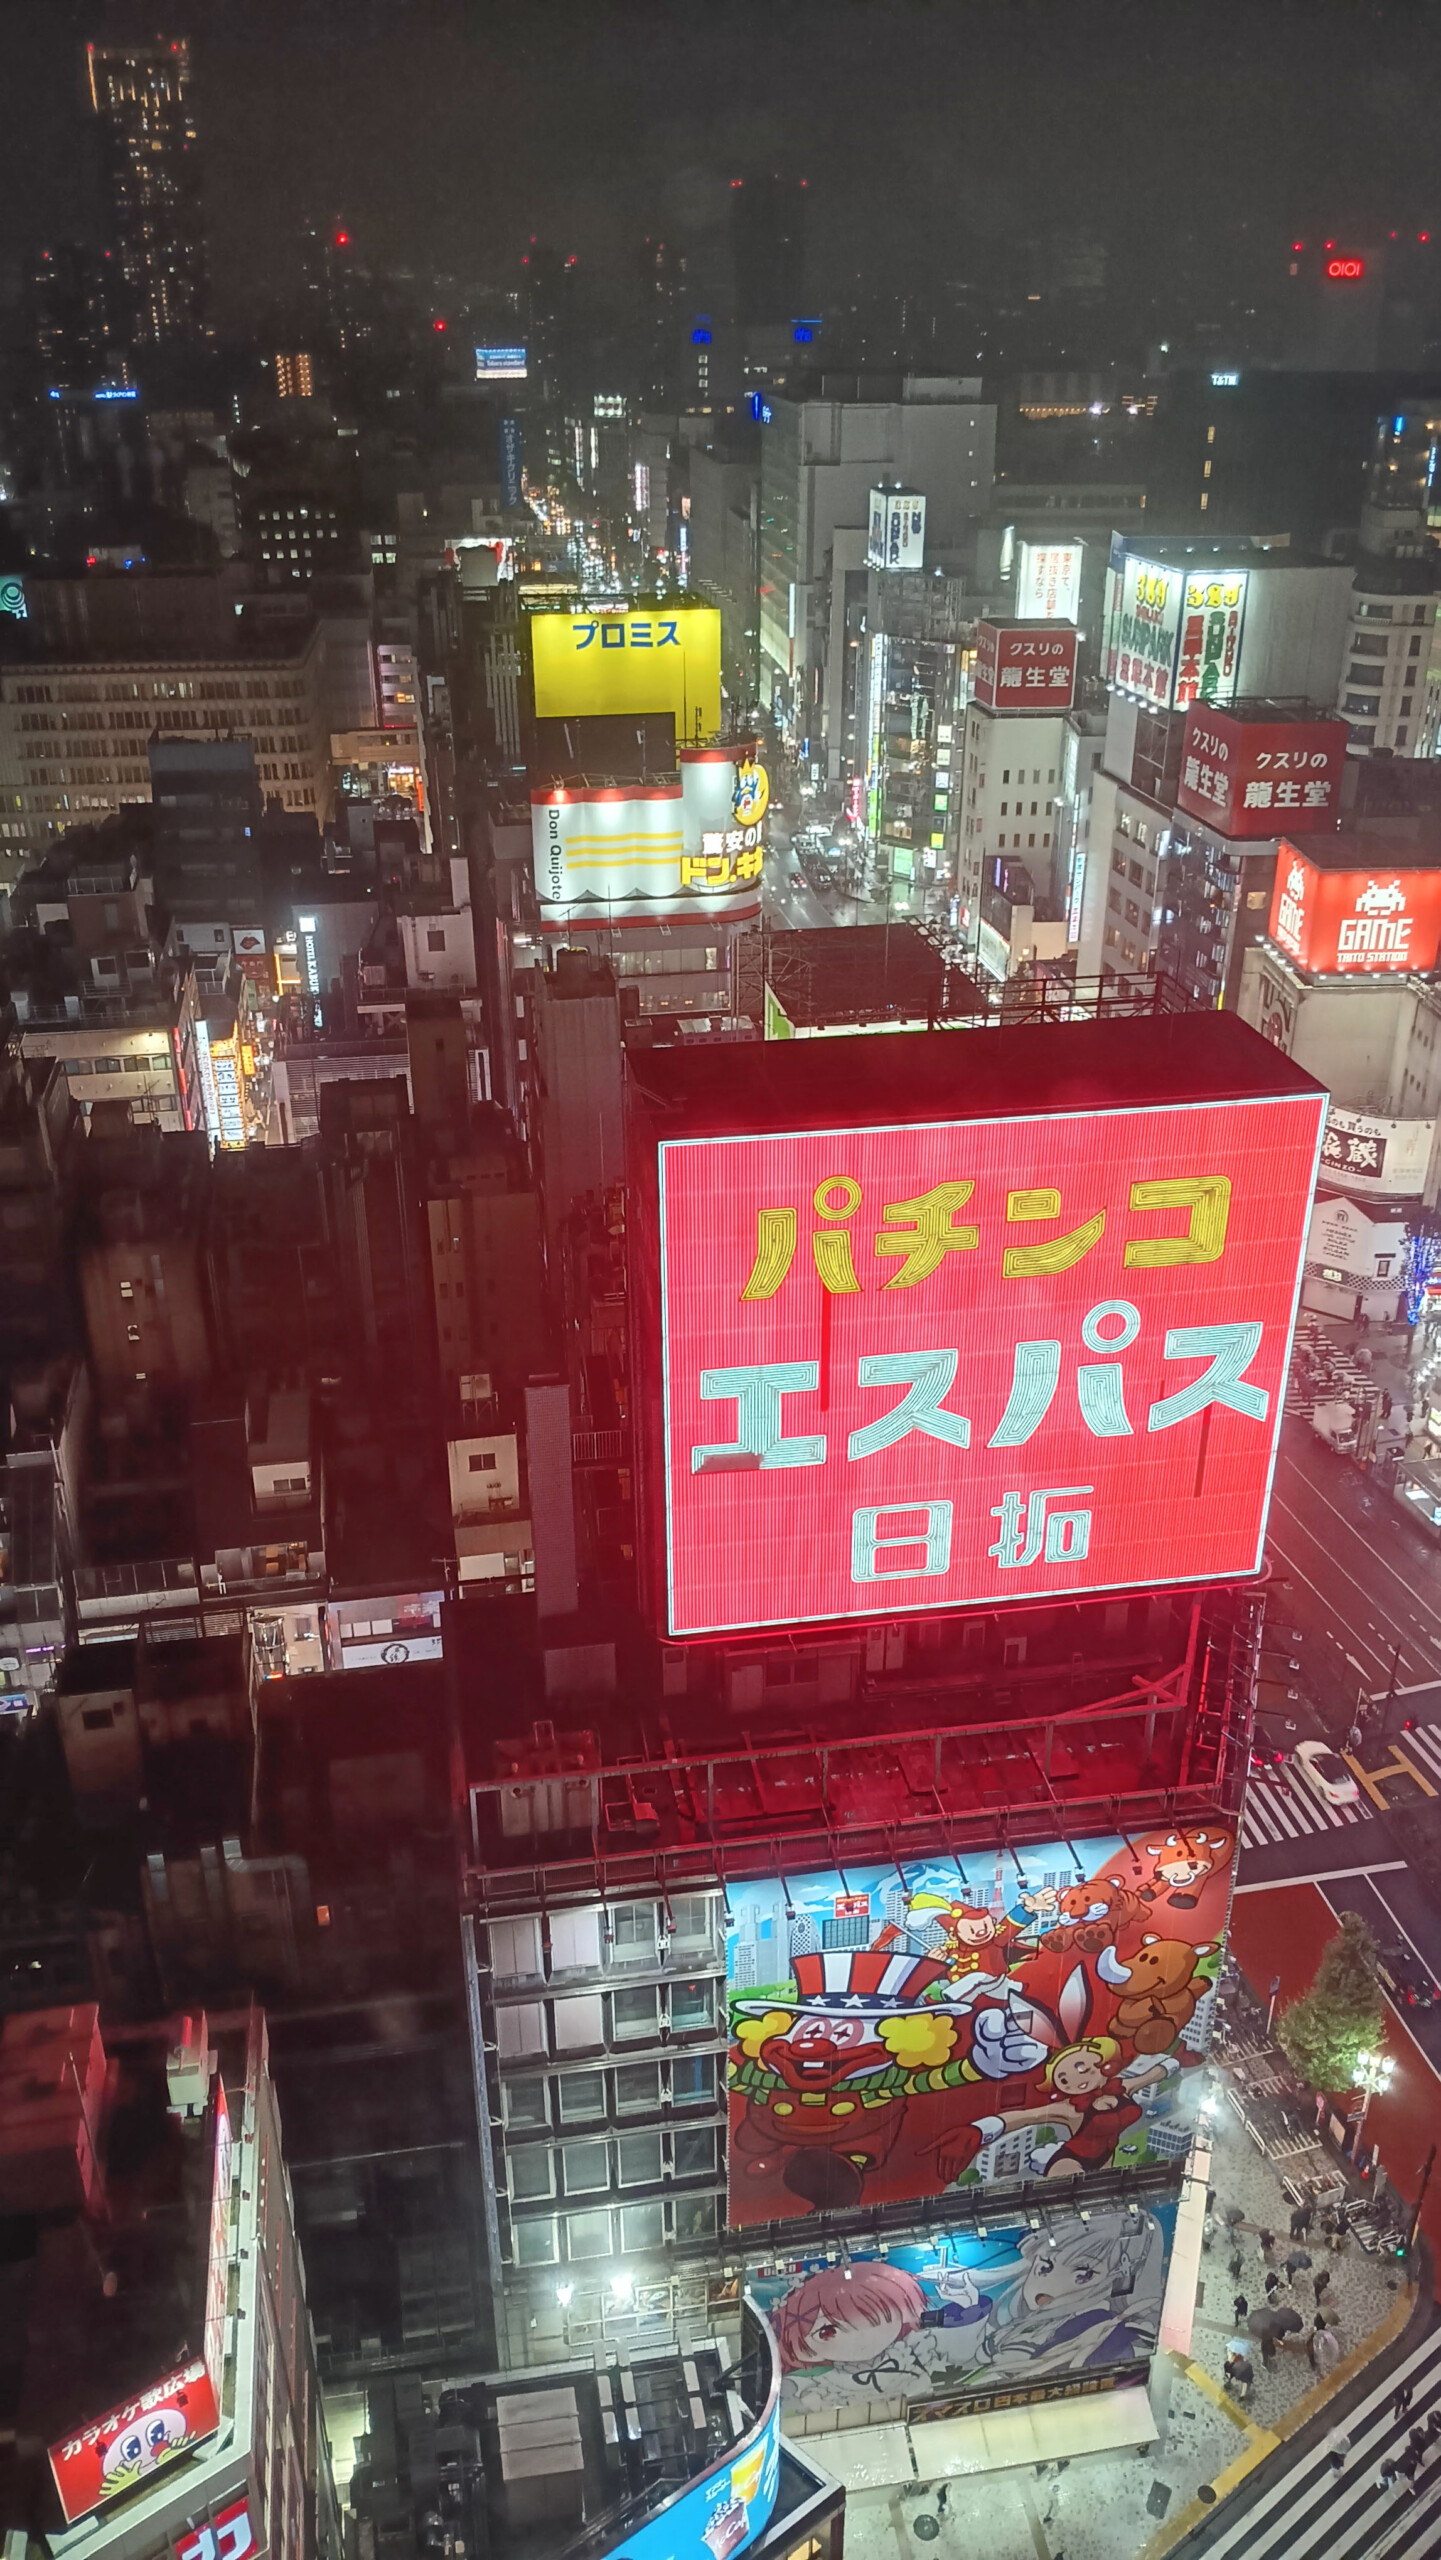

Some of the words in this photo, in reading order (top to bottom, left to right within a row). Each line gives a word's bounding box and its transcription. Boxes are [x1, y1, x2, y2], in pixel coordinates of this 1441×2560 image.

[573, 620, 681, 650] プロミス
[1009, 642, 1064, 656] クスリの
[999, 665, 1070, 688] 龍生堂
[1192, 727, 1229, 762] クスリの
[1256, 751, 1328, 770] クスリの
[1184, 755, 1229, 808] 龍生堂
[1242, 780, 1332, 809] 龍生堂
[548, 809, 560, 840] Don
[548, 844, 563, 900] Quijote
[1336, 918, 1414, 951] GAME
[1336, 952, 1366, 963] TAITO
[1366, 951, 1408, 963] STATION
[740, 1174, 1232, 1301] パチンコ
[690, 1299, 1269, 1475] エスパス
[62, 2359, 206, 2462] カラオケ歌広場
